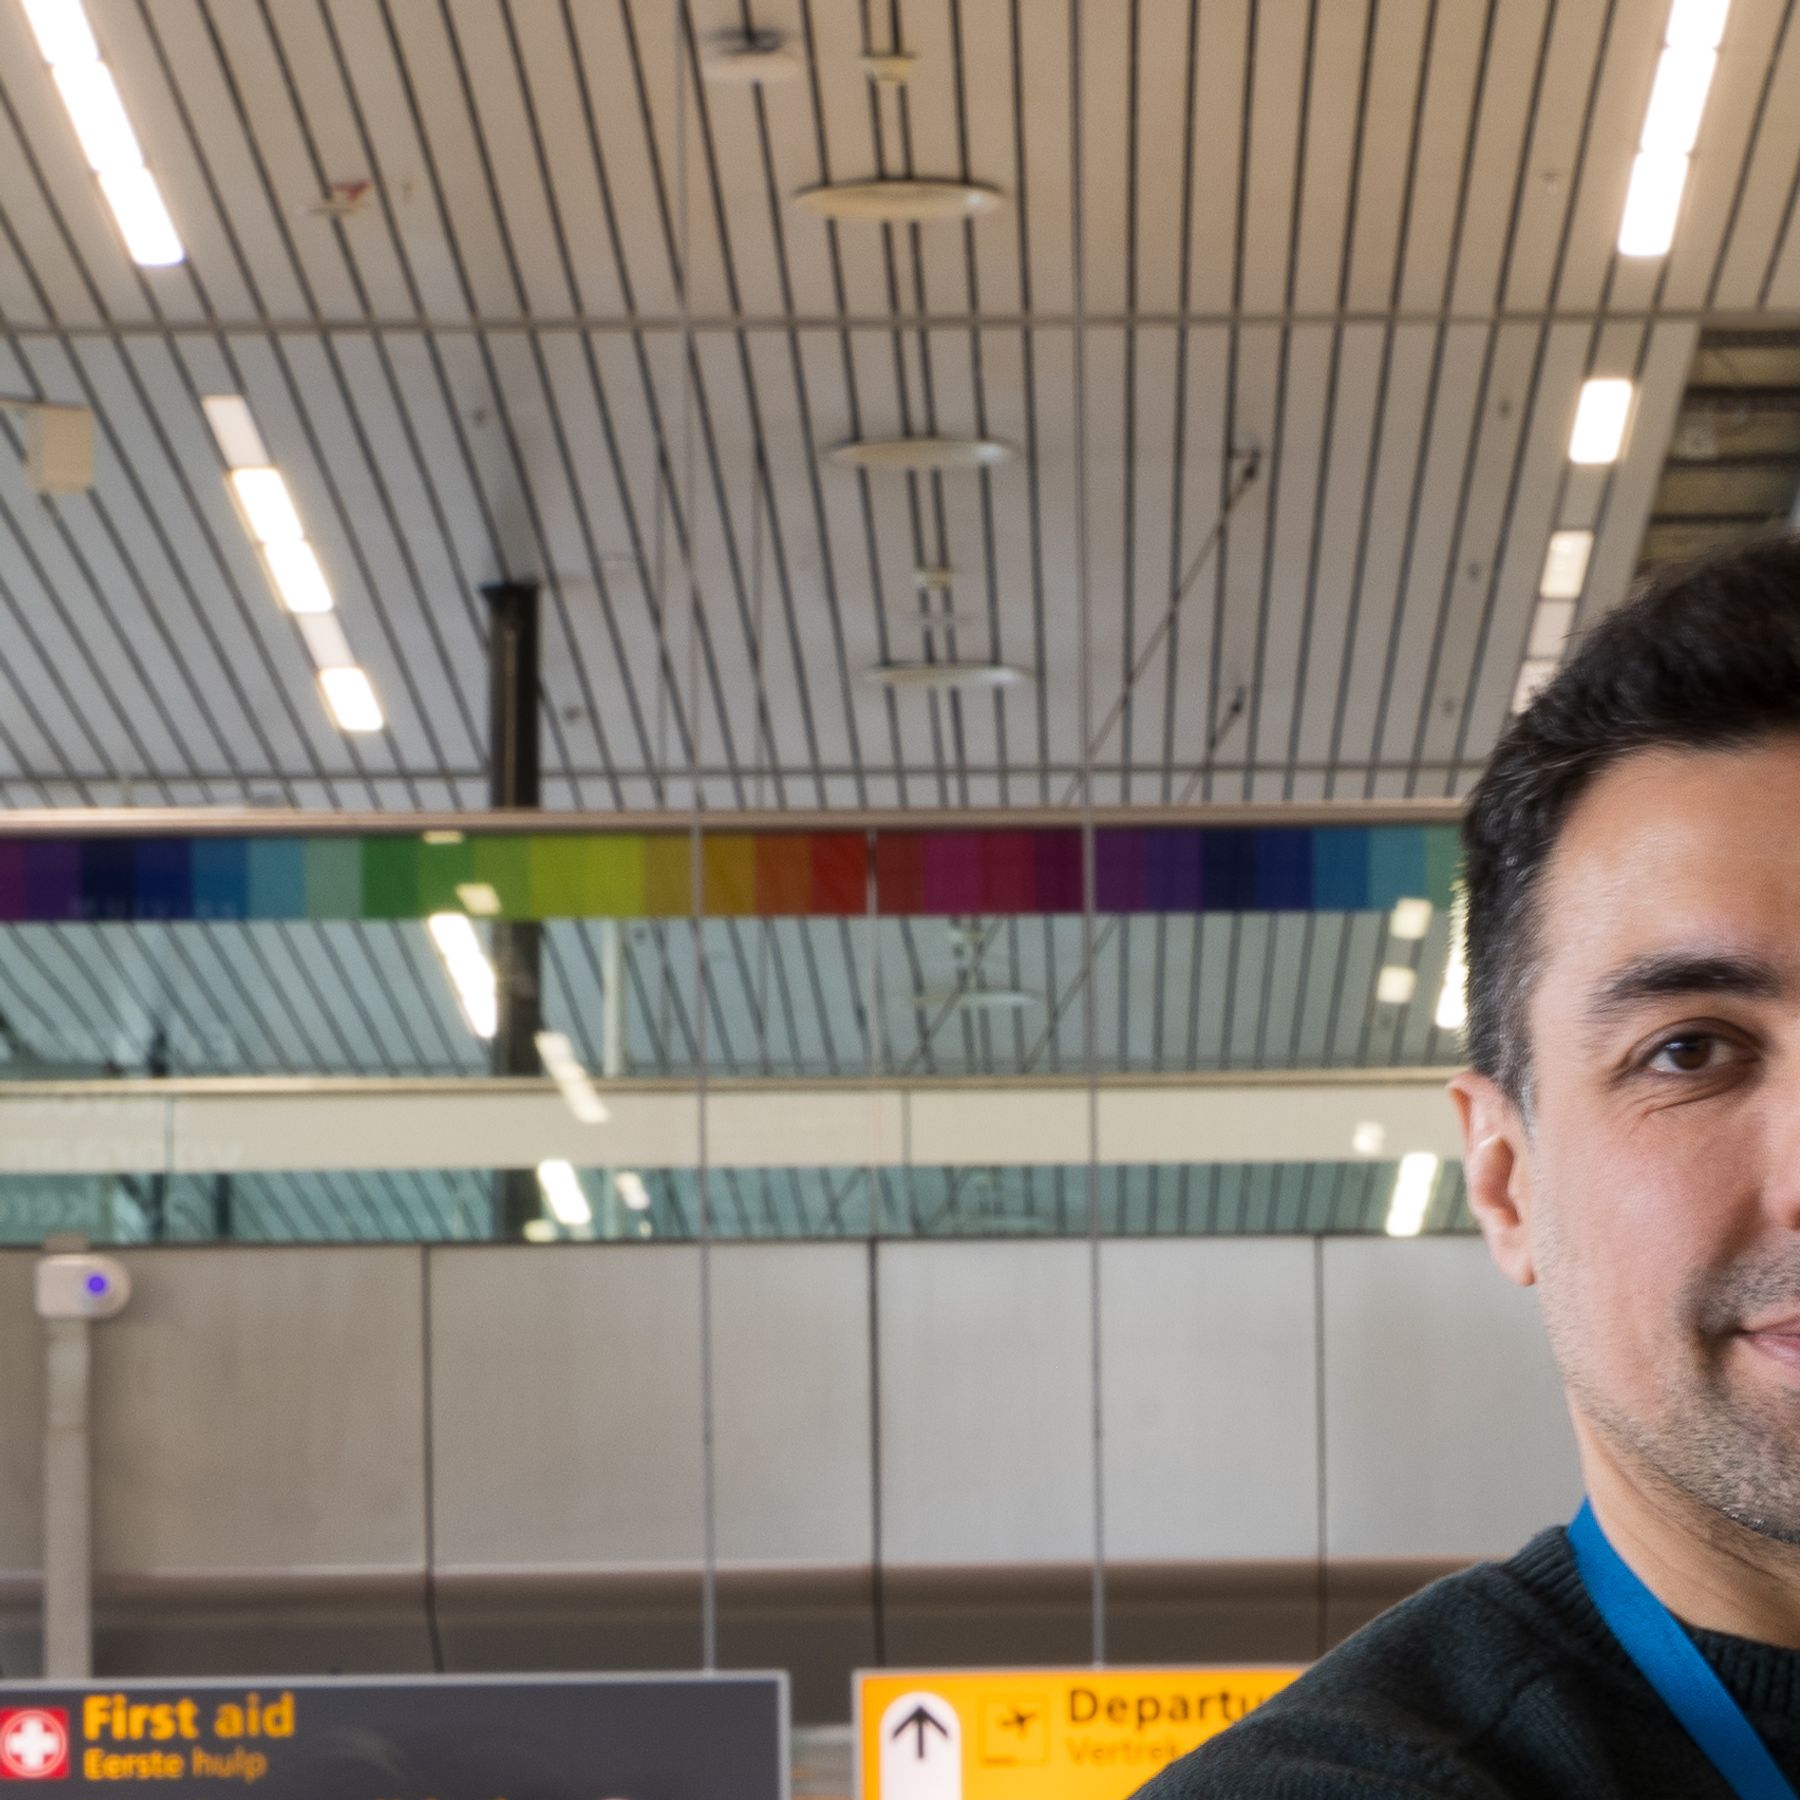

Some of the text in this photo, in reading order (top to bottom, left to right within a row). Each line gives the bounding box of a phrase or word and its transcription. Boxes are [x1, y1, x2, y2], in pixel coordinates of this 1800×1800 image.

[83, 1691, 294, 1740] First aid
[84, 1746, 267, 1782] Eerste hulp
